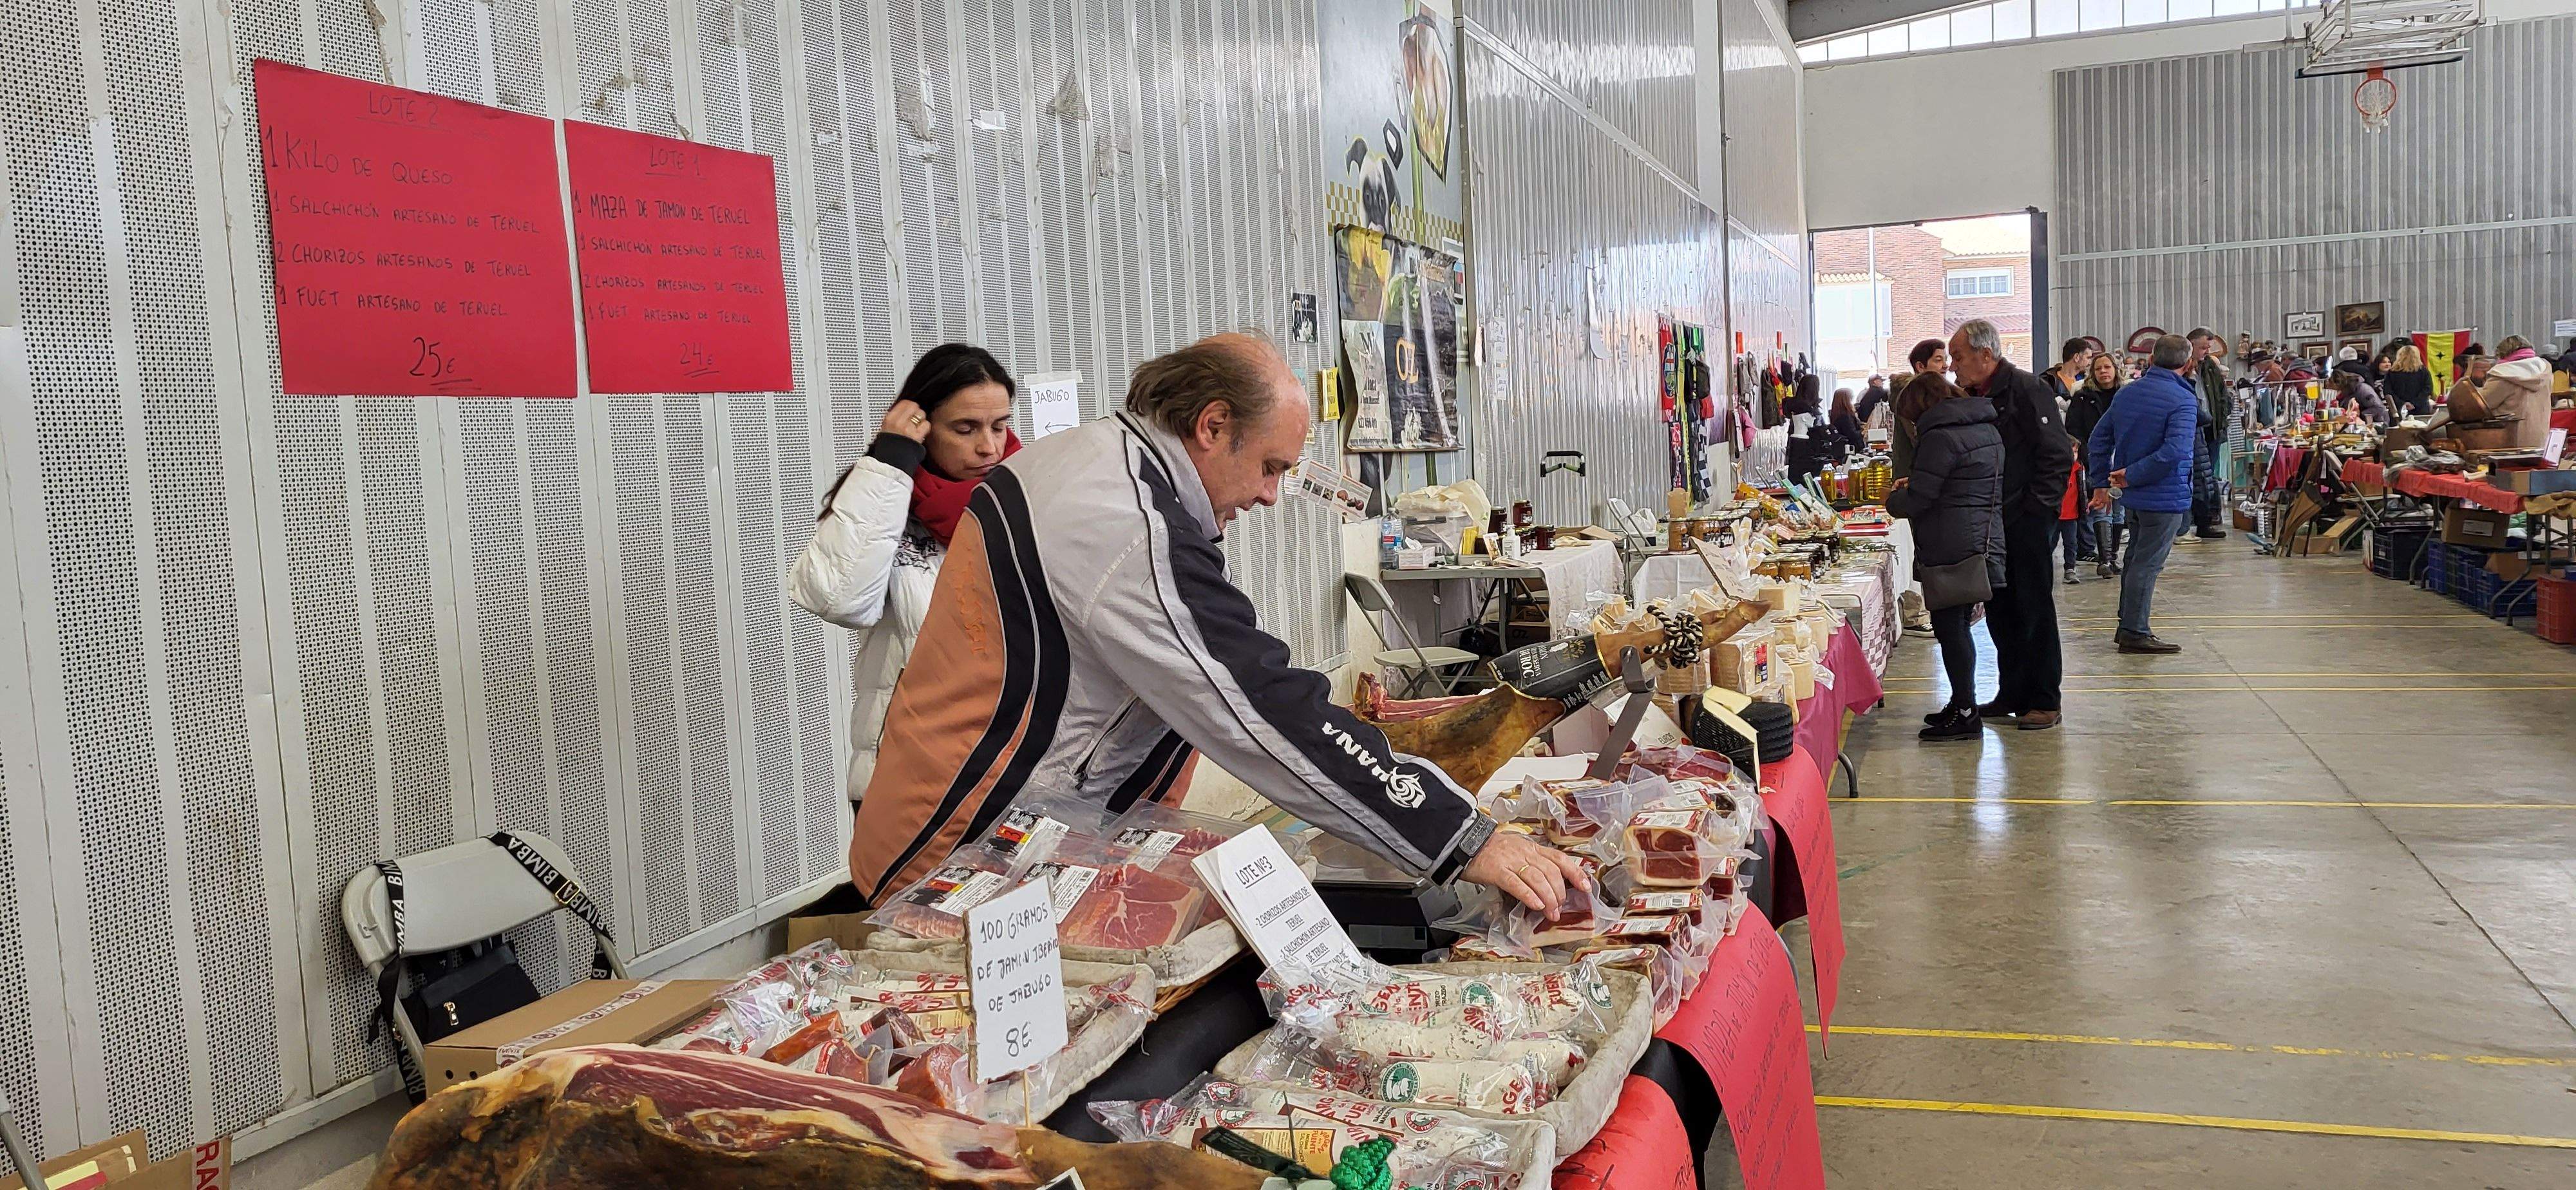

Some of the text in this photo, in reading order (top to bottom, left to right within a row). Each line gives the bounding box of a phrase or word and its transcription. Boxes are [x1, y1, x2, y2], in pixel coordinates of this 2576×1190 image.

[369, 90, 439, 126] LOTE 2
[265, 125, 279, 167] 1
[353, 159, 373, 177] DE
[392, 162, 453, 185] QUESO
[650, 146, 701, 176] LOTE 1
[274, 190, 280, 212] 1
[393, 209, 457, 225] ARTESANO
[466, 215, 480, 228] DE
[490, 215, 540, 234] TERUEL
[573, 192, 582, 214] 1
[590, 194, 627, 221] MAZA
[636, 198, 648, 218] DE
[691, 206, 705, 222] DE
[708, 205, 752, 225] TERUEL
[276, 240, 532, 277] 2 CHORIZOS ARTESANOS DE TERUEL
[580, 234, 586, 251] 1
[661, 243, 708, 257] ARTESANO
[714, 247, 722, 258] DE
[730, 247, 767, 261] TERUEL
[584, 273, 764, 295] 2 CHORIZOS ARTESANOS DE TERUEL
[278, 285, 508, 317] 1 FUET ARTESANO DE TERUEL
[598, 301, 628, 319] FUET
[644, 308, 691, 321] ARTESANO
[698, 310, 708, 320] DE
[717, 310, 752, 323] TERUEL
[1396, 337, 1419, 384] OZ
[1034, 389, 1070, 404] JABUGO
[1519, 648, 1535, 679] DUROC
[507, 836, 560, 886] BIMBA
[1235, 864, 1260, 886] LOTE
[562, 883, 605, 931] BIMBA
[1260, 903, 1282, 923] CHORIZOS
[1278, 890, 1303, 911] ARTESANOS
[1302, 885, 1311, 896] DE
[981, 902, 1048, 944] 100 GRAMOS
[1285, 914, 1303, 929] TERUEL
[1307, 917, 1331, 938] ARTESANO
[1305, 942, 1329, 963] DE TERUEL
[977, 959, 993, 981] DE
[989, 974, 1052, 1012] DE JABUGO
[1309, 1129, 1319, 1155] FUENTE
